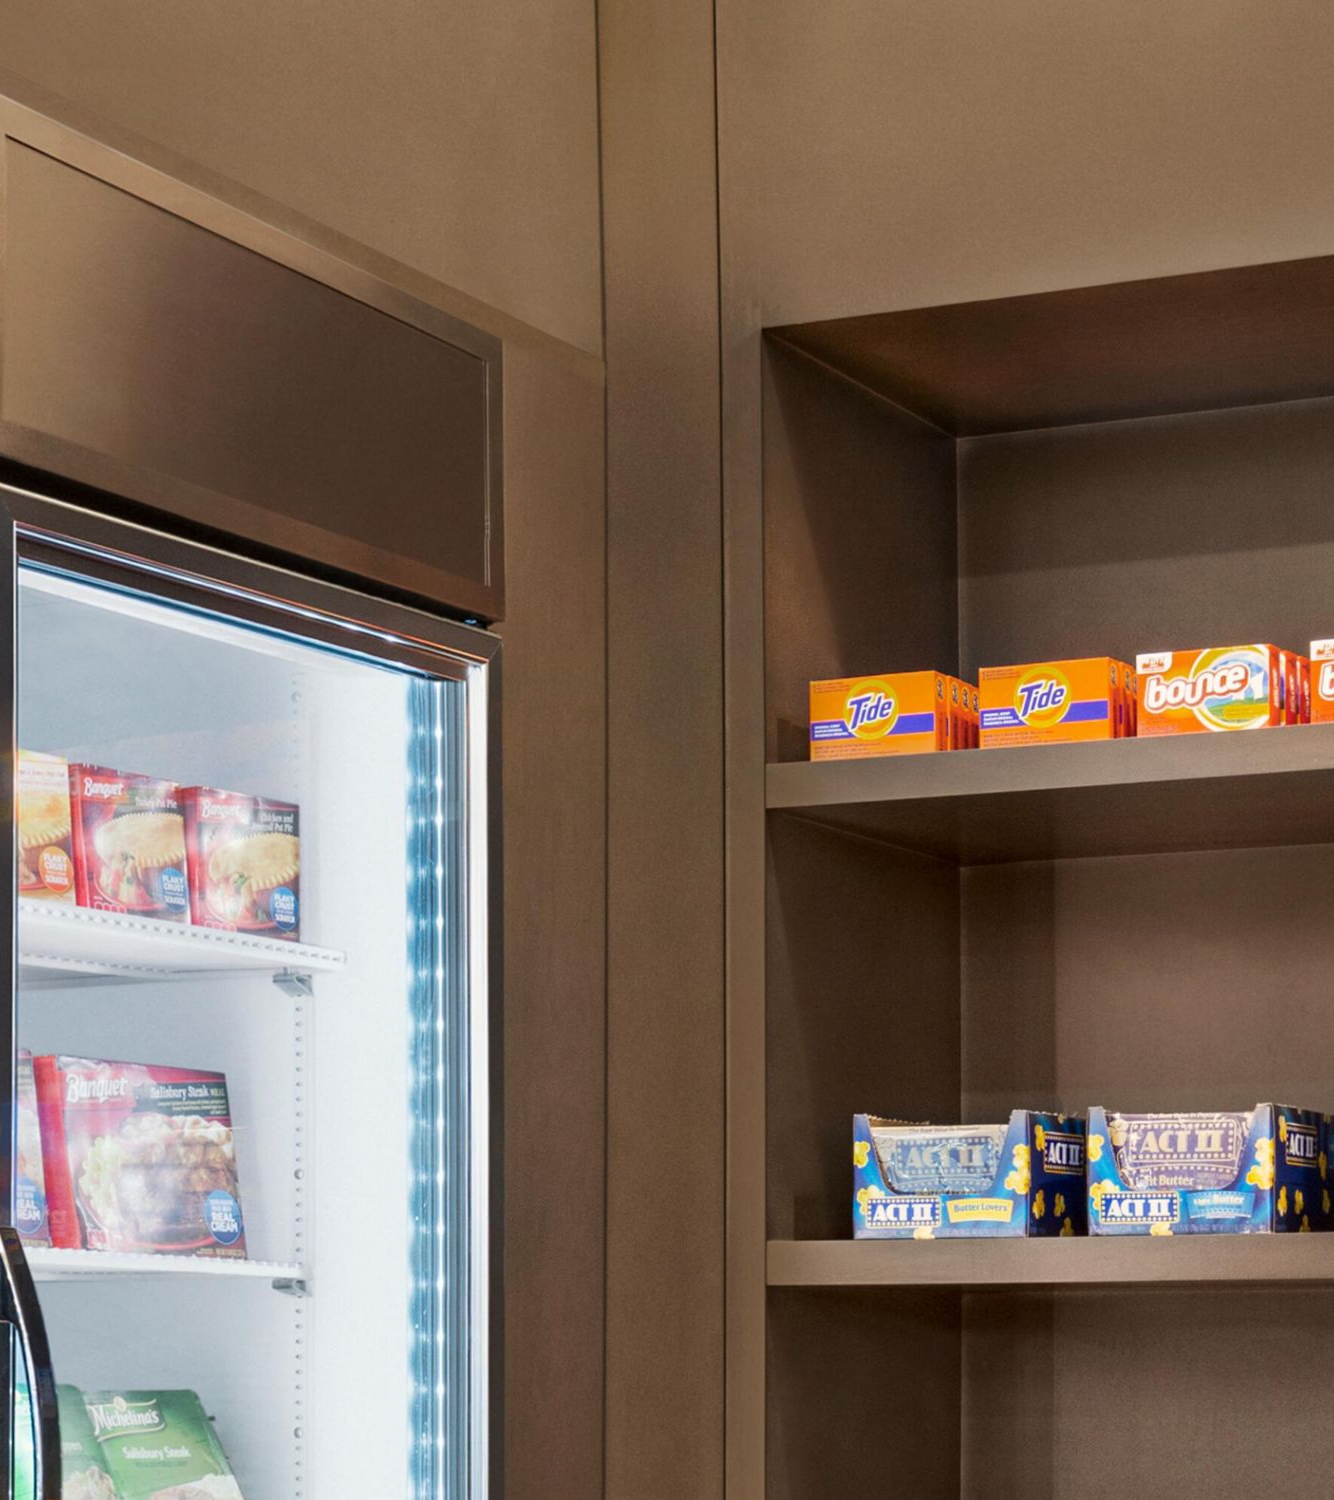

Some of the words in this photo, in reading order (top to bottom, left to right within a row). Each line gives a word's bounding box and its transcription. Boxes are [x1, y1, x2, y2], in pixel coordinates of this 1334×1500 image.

[1019, 680, 1066, 717] Tide
[1149, 664, 1247, 710] bounce
[848, 694, 894, 730] Tide
[67, 1074, 129, 1104] Banquet
[151, 1085, 187, 1100] Salisbury
[188, 1086, 210, 1098] Steak
[1143, 1130, 1192, 1154] ACT
[1194, 1130, 1224, 1152] II
[1289, 1134, 1304, 1156] ACT
[1304, 1136, 1314, 1157] II
[905, 1145, 951, 1169] ACT
[958, 1145, 985, 1167] II
[1048, 1142, 1068, 1164] ACT
[1069, 1143, 1080, 1166] II
[1158, 1174, 1194, 1186] Butter
[873, 1202, 909, 1222] ACT
[911, 1202, 934, 1222] II
[953, 1202, 980, 1212] Butter
[981, 1202, 1008, 1212] Lovers
[1108, 1198, 1146, 1217] ACT
[1148, 1198, 1172, 1216] II
[1212, 1195, 1244, 1206] Butter
[87, 1404, 161, 1436] Michelina's
[122, 1446, 165, 1460] Salisbury
[166, 1447, 192, 1458] Steak
